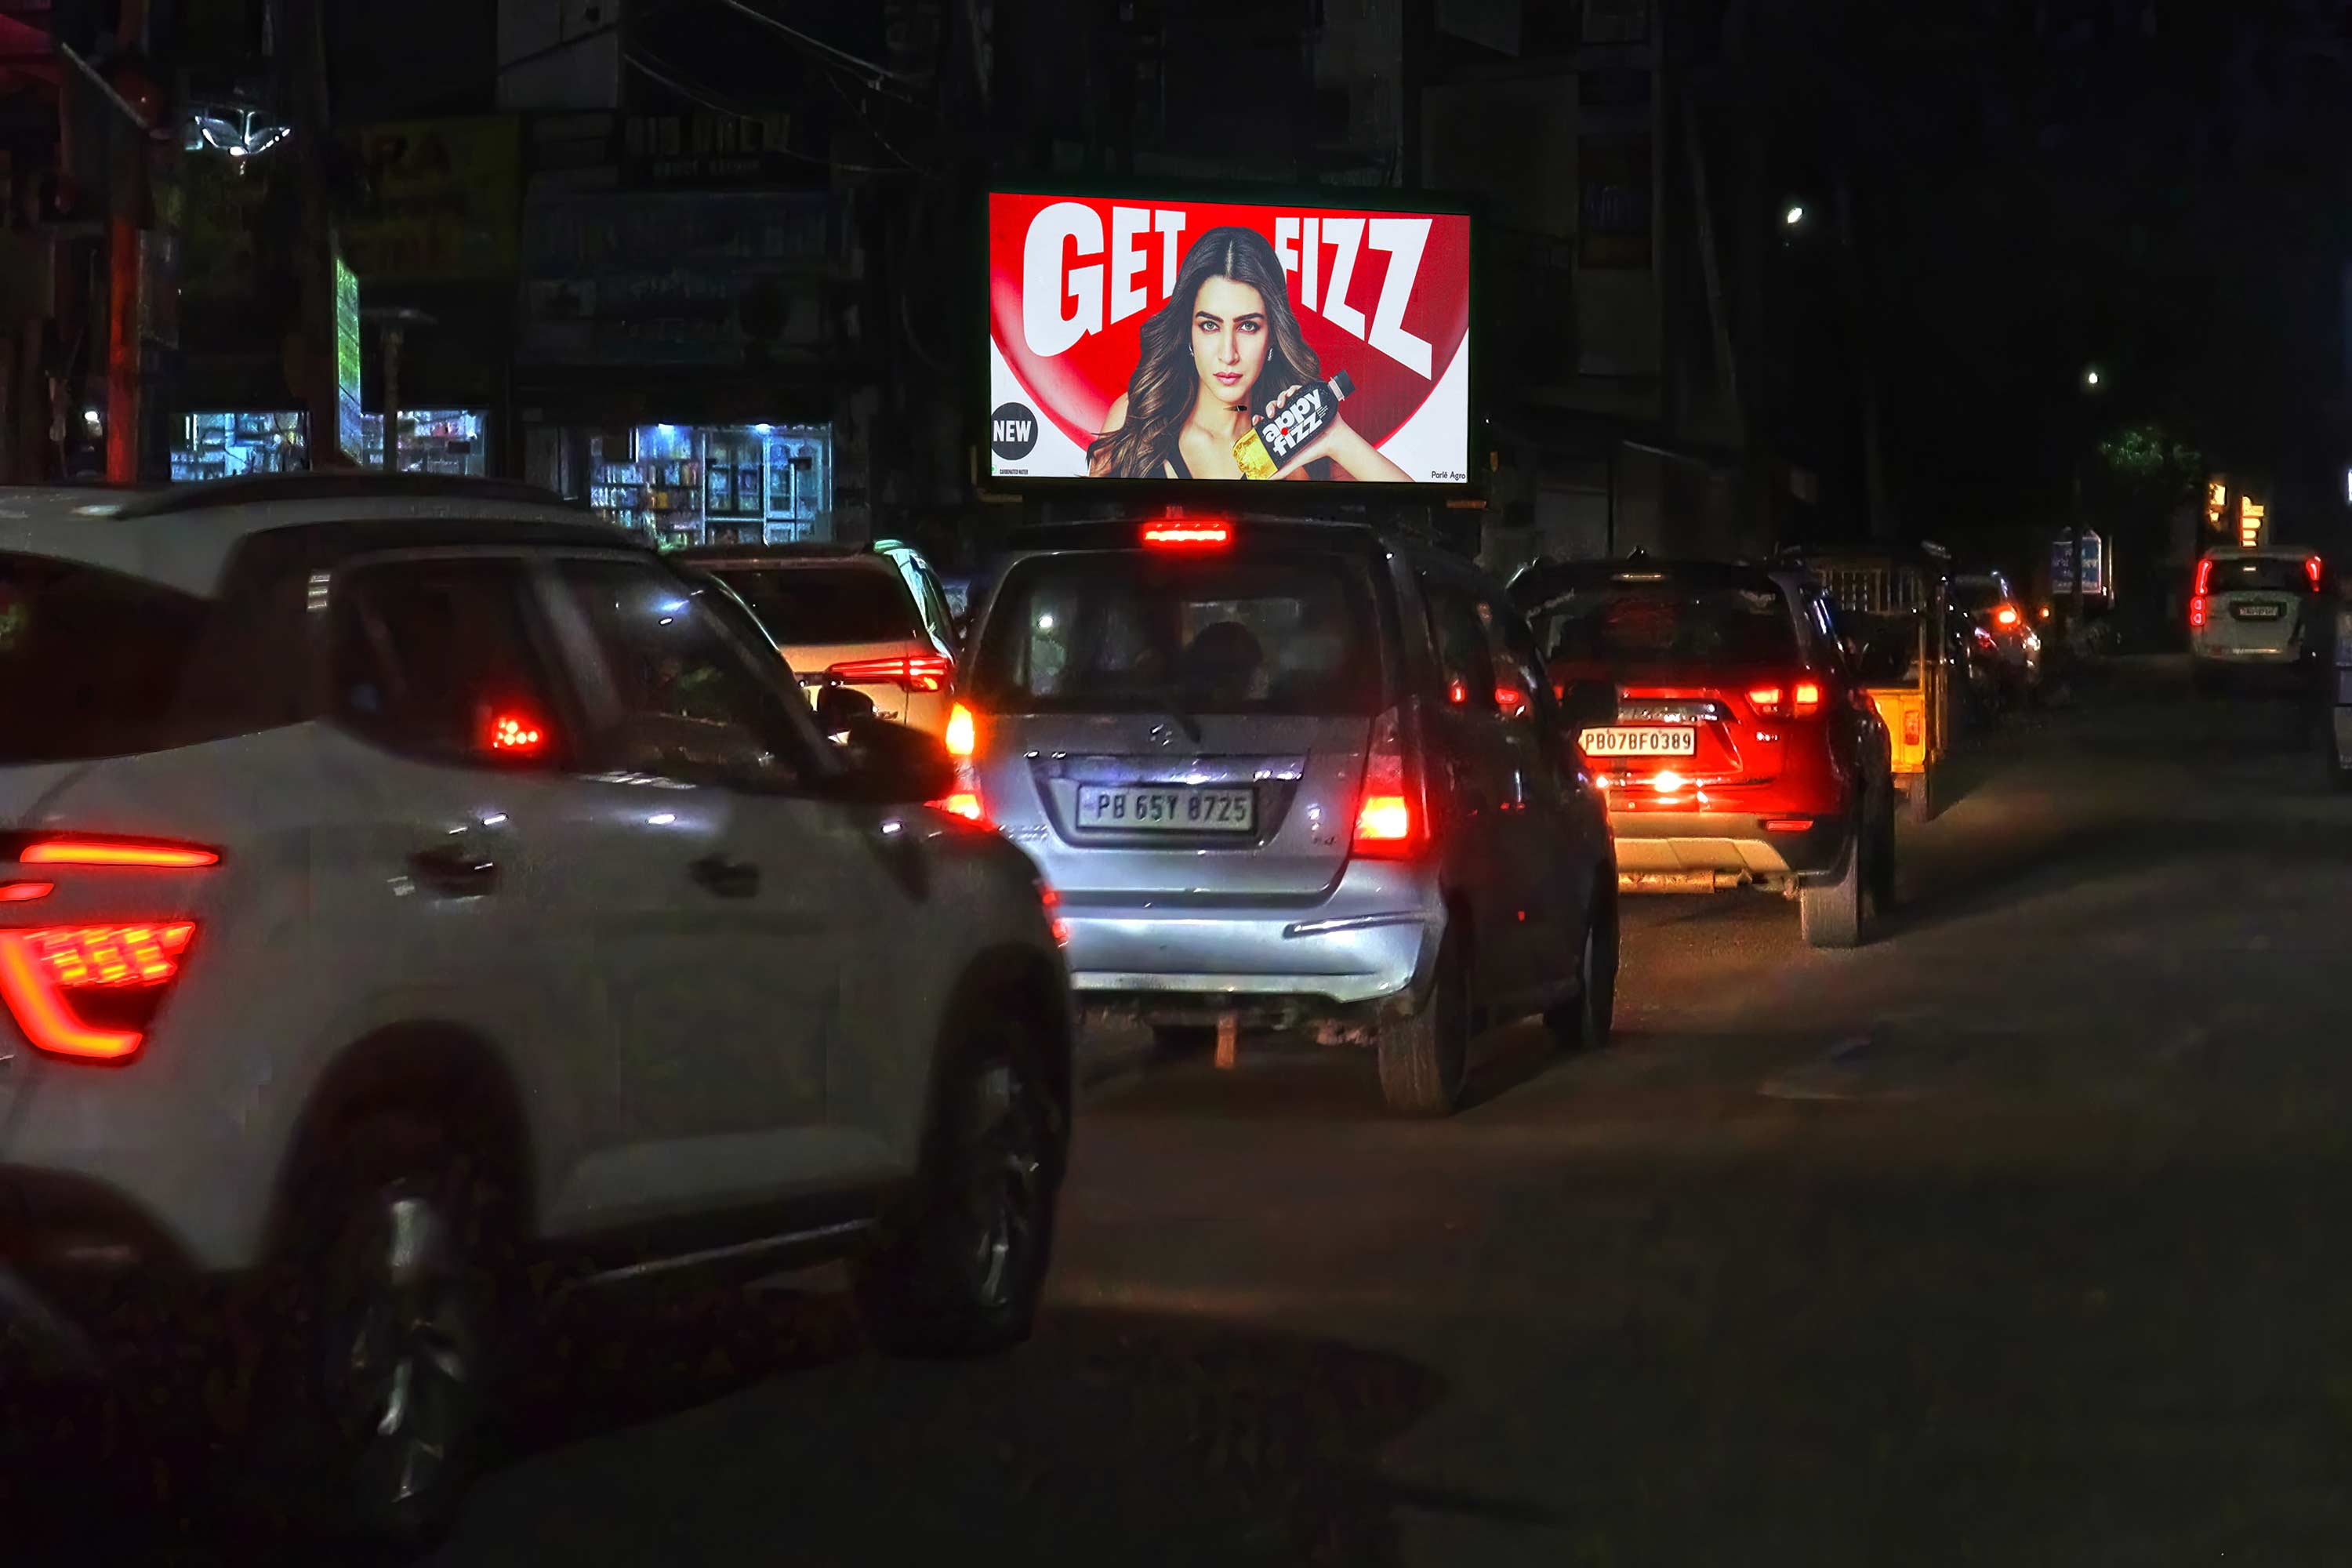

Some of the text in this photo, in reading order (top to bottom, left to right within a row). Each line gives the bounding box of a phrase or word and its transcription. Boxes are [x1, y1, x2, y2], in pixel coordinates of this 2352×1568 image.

[1022, 201, 1432, 380] GET FIZZ
[1262, 389, 1322, 443] appy
[993, 420, 1032, 442] NEW
[1272, 412, 1323, 456] fizz
[1450, 471, 1466, 481] Agro
[1585, 733, 1691, 750] PB07BF0389
[1098, 794, 1246, 822] PB 65Y 8725
